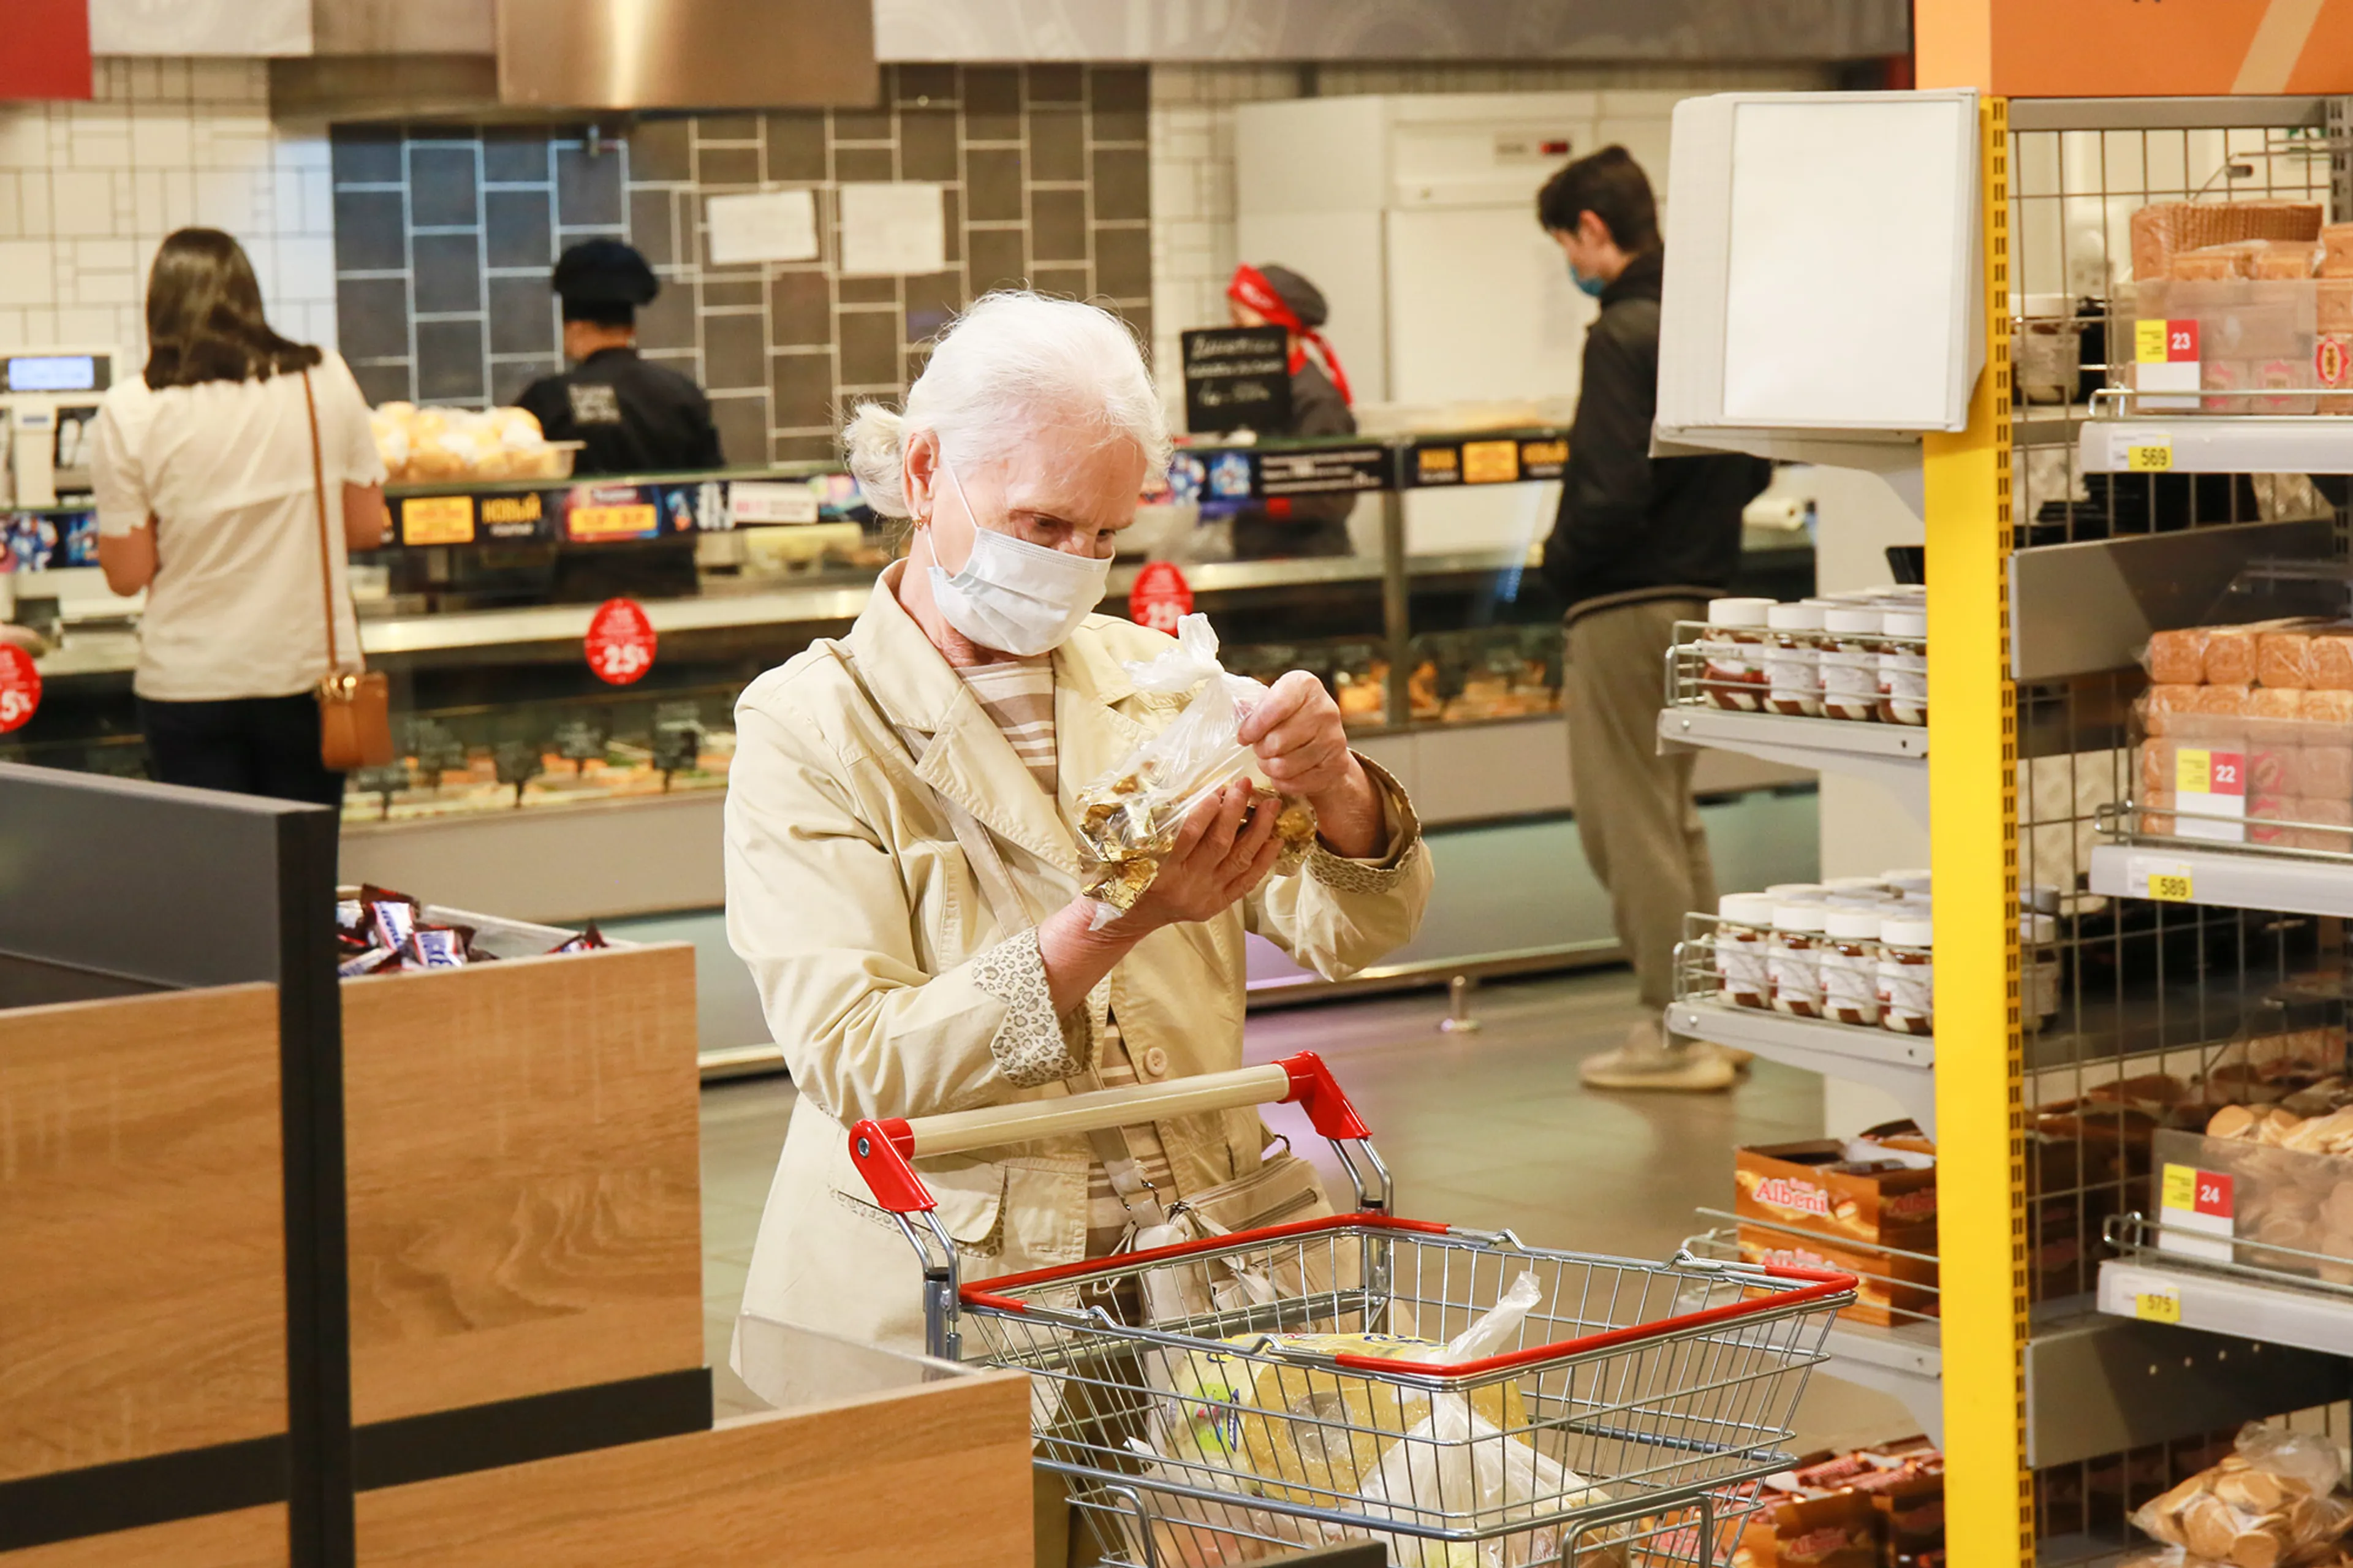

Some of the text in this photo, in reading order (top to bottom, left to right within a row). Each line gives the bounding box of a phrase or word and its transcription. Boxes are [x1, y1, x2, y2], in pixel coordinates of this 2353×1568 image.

[2172, 332, 2191, 350] 23
[2141, 447, 2168, 467] 569
[0, 691, 33, 722] 5%
[2215, 764, 2236, 783] 22
[1754, 1179, 1828, 1215] Albeni
[2200, 1184, 2221, 1204] 24
